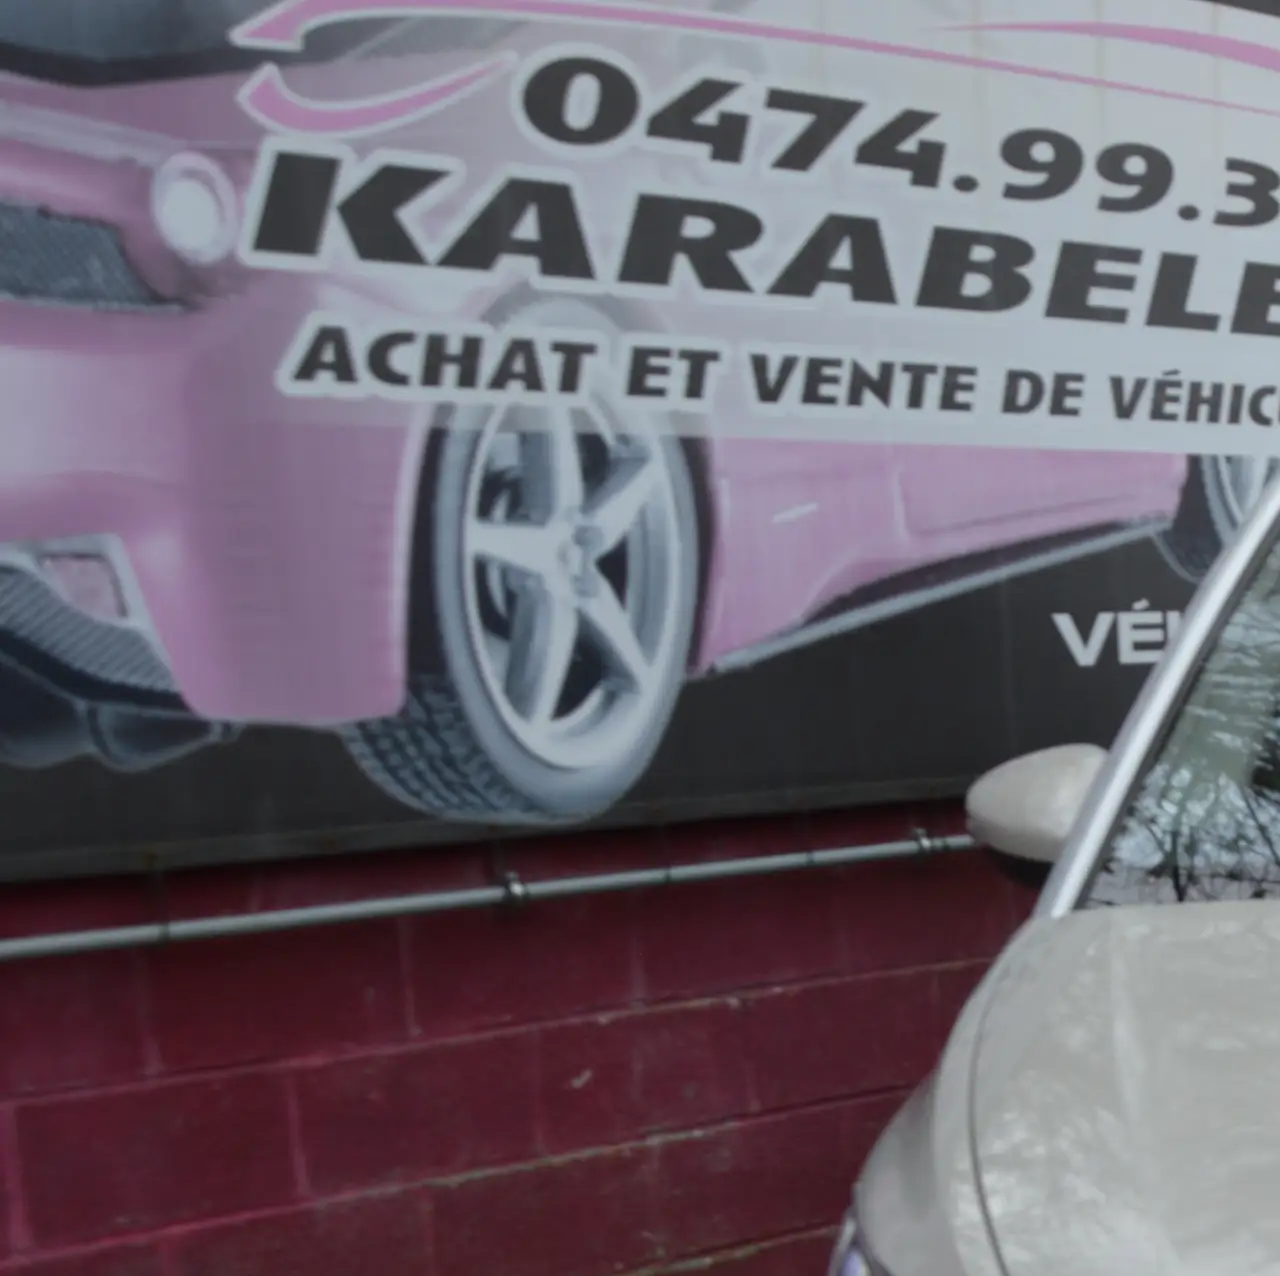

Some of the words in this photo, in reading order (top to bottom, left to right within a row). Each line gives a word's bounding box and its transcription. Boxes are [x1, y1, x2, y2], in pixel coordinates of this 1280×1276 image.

[293, 326, 597, 394] ACHAT
[626, 346, 720, 399] ET
[750, 353, 978, 412] VENTE
[1002, 370, 1085, 416] DE
